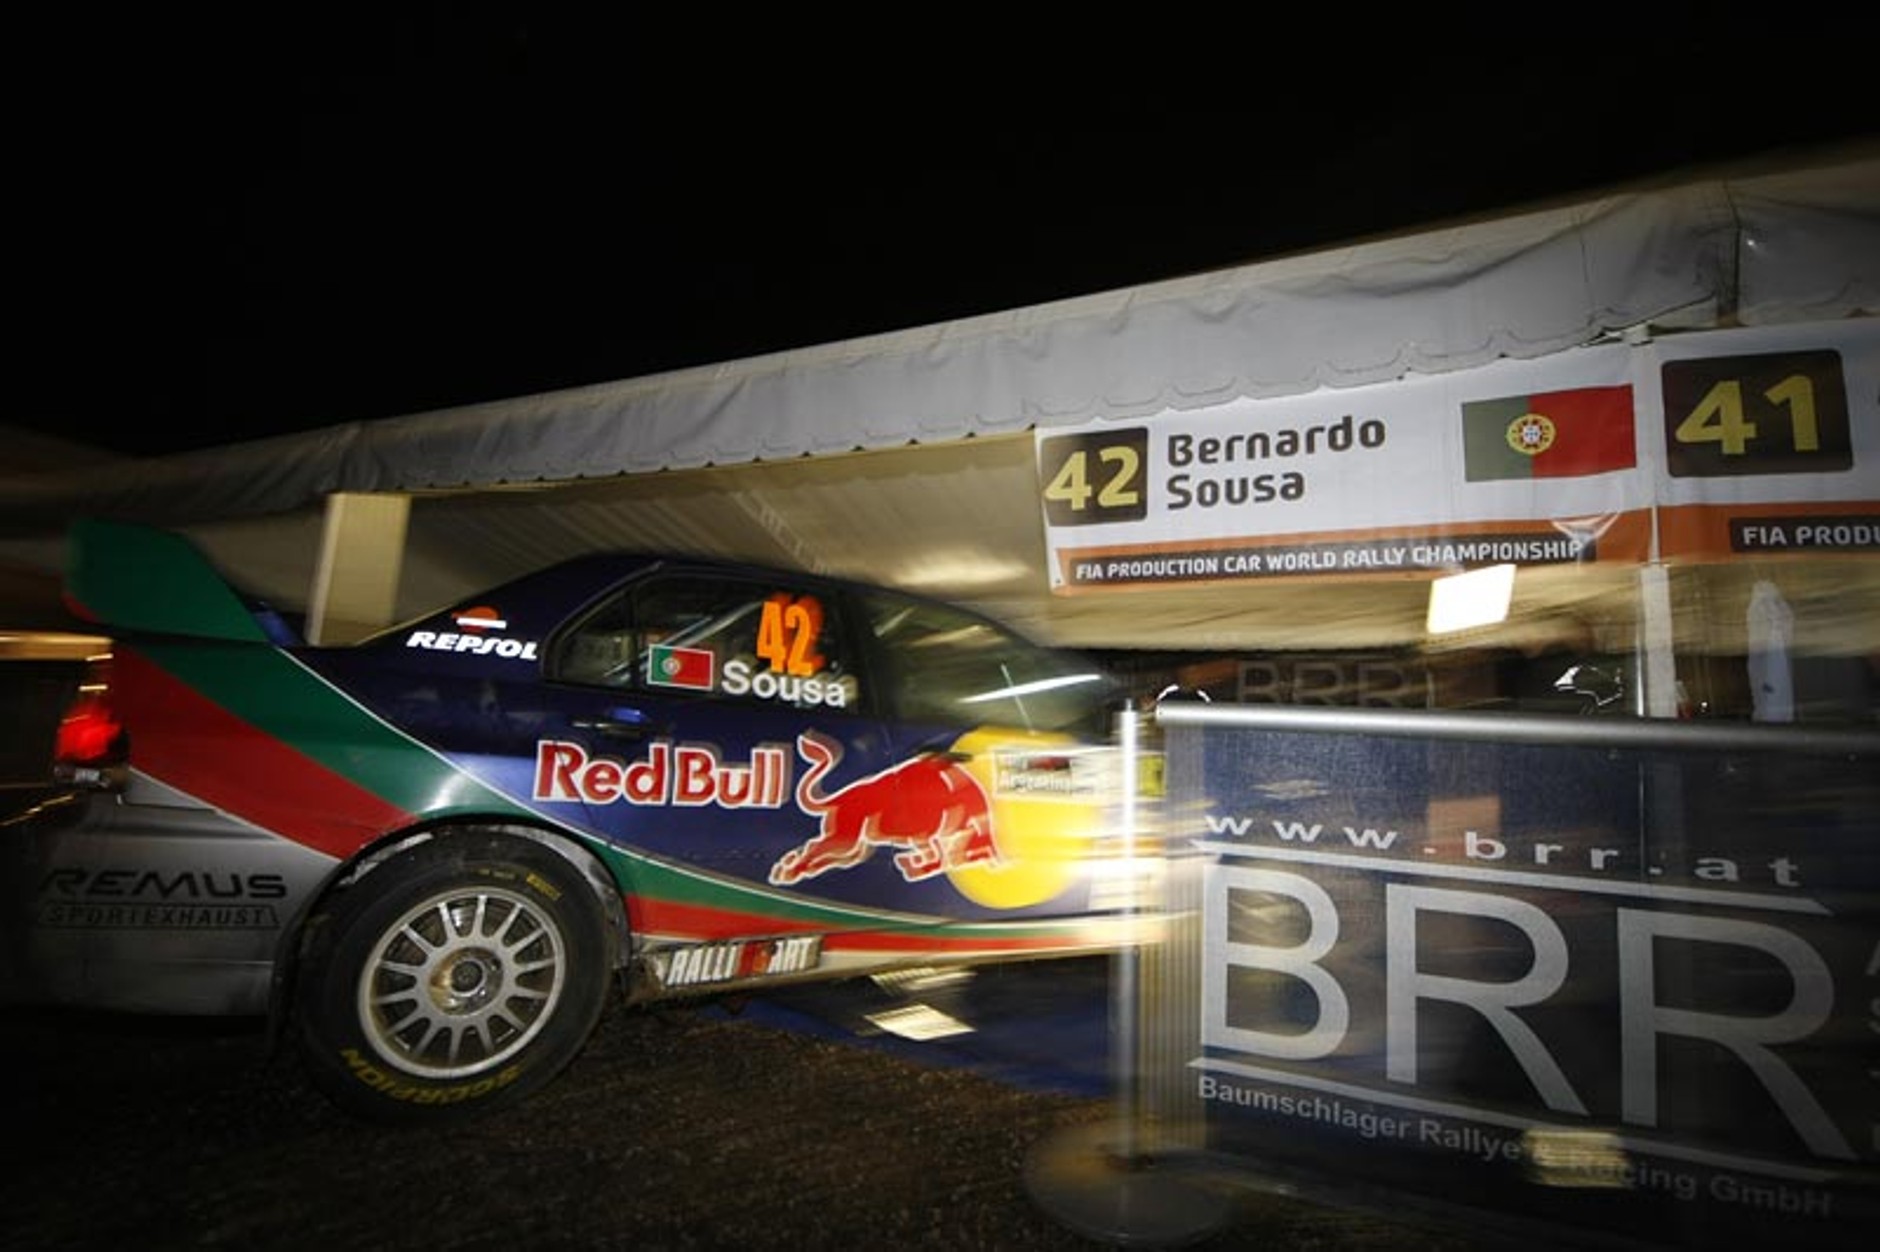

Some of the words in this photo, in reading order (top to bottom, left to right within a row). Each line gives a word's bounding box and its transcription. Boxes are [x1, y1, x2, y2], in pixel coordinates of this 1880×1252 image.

[1676, 375, 1819, 455] 41
[1167, 416, 1386, 467] Bernardo
[1045, 446, 1140, 511] 42
[1166, 472, 1305, 510] Sousa
[1076, 563, 1104, 580] FIA
[1107, 557, 1218, 578] PRODUCTION
[1223, 556, 1261, 573] CAR
[1266, 551, 1336, 571] WORLD
[1343, 547, 1406, 568] RALLY
[1411, 540, 1584, 564] CHAMPIONSHIP
[1743, 525, 1787, 546] FIA
[407, 631, 538, 661] REPSOL
[757, 599, 820, 676] 42
[721, 660, 847, 708] Sousa
[533, 740, 669, 805] Red
[672, 746, 787, 808] Bull
[37, 868, 287, 899] REMUS
[47, 905, 269, 926] SPORTEXHAUST
[1202, 863, 1860, 1161] BRR
[1199, 1075, 1412, 1138] Baumschlager
[1419, 1118, 1521, 1163] Rallye
[1709, 1174, 1835, 1218] GmbH
